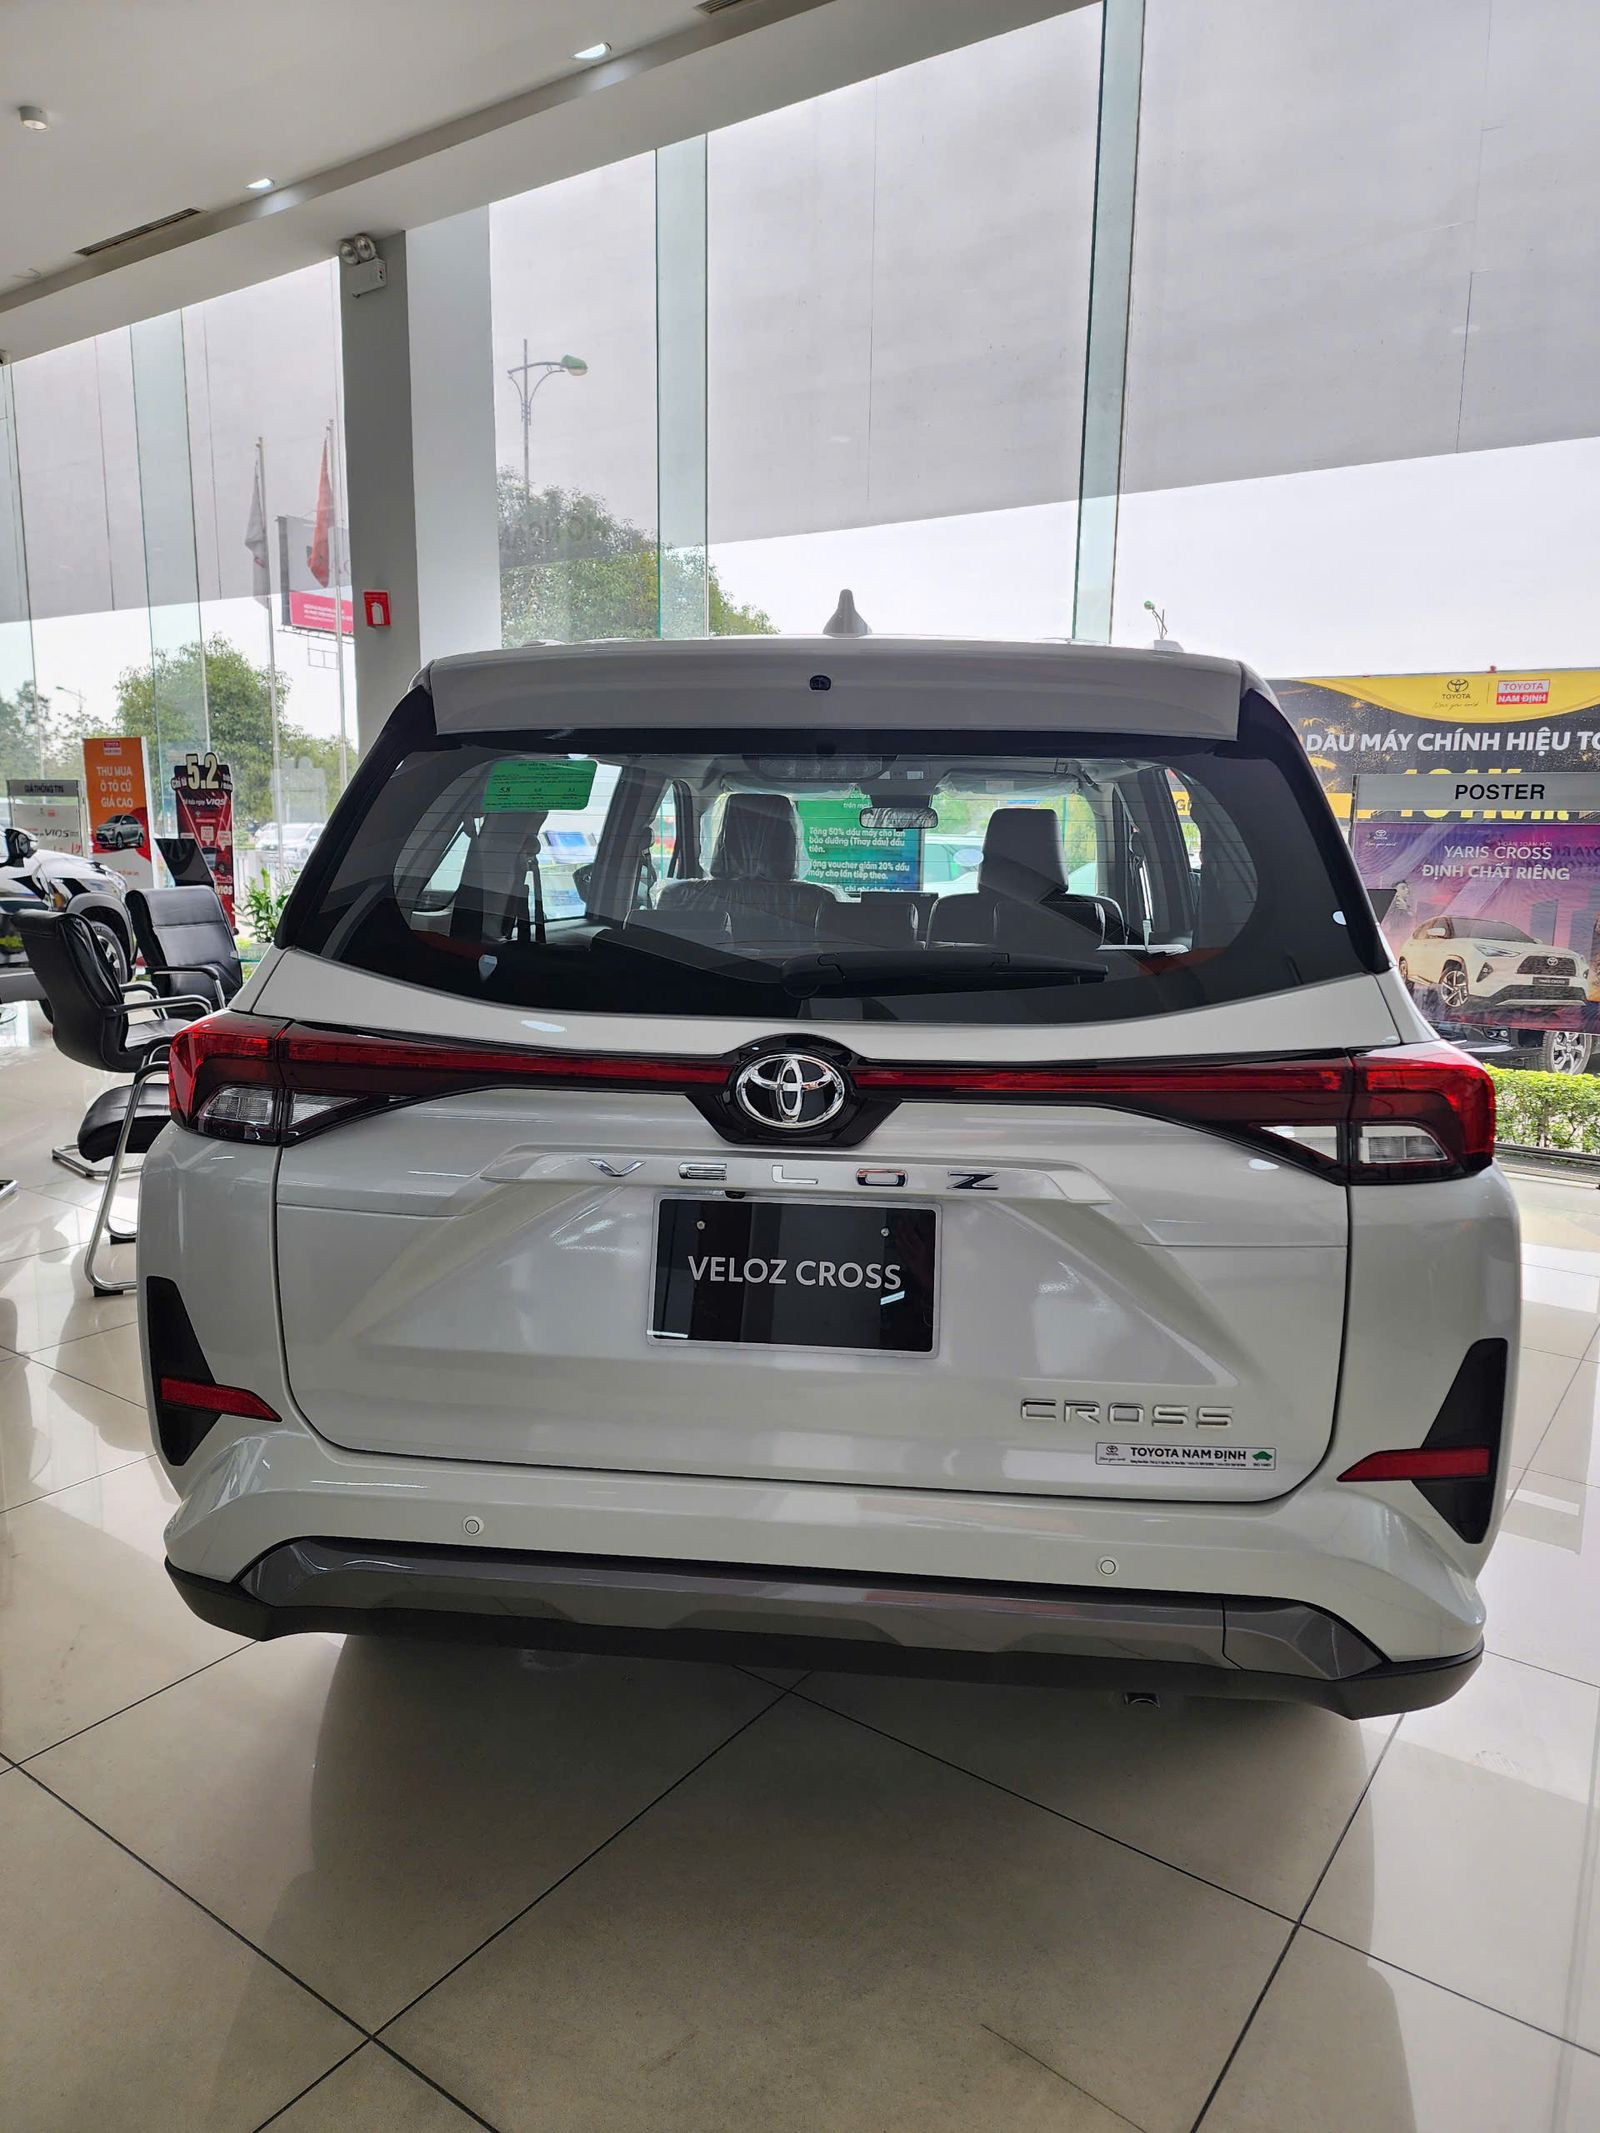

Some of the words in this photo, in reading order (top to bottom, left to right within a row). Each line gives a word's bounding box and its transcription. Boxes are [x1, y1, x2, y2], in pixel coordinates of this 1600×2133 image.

[1503, 682, 1544, 692] TOYOTA
[1498, 694, 1521, 704] NAM
[1521, 693, 1547, 704] ĐỊNH
[1360, 729, 1414, 752] MÁY
[1417, 727, 1501, 752] CHÍNH
[1506, 727, 1570, 757] HIỆU
[96, 766, 113, 776] THU
[114, 767, 132, 777] MUA
[186, 752, 219, 790] 5.2
[1455, 784, 1546, 800] POSTER
[102, 794, 116, 808] GIÁ
[116, 796, 133, 808] CAO
[45, 828, 69, 838] VIOS
[1444, 845, 1490, 859] YARIS
[1494, 846, 1552, 860] CROSS
[828, 862, 857, 870] voucher
[878, 862, 894, 871] 20%
[1422, 864, 1464, 881] ĐỊNH
[1468, 862, 1513, 879] CHẤT
[1516, 864, 1570, 881] RIÊNG
[588, 1158, 1000, 1190] VELOZ
[688, 1256, 788, 1285] VELOZ
[795, 1260, 902, 1290] CROSS
[1021, 1398, 1234, 1430] CROSS
[1130, 1447, 1180, 1458] TOYOTA
[1182, 1449, 1212, 1459] NAM
[1214, 1450, 1247, 1462] ĐỊNH
